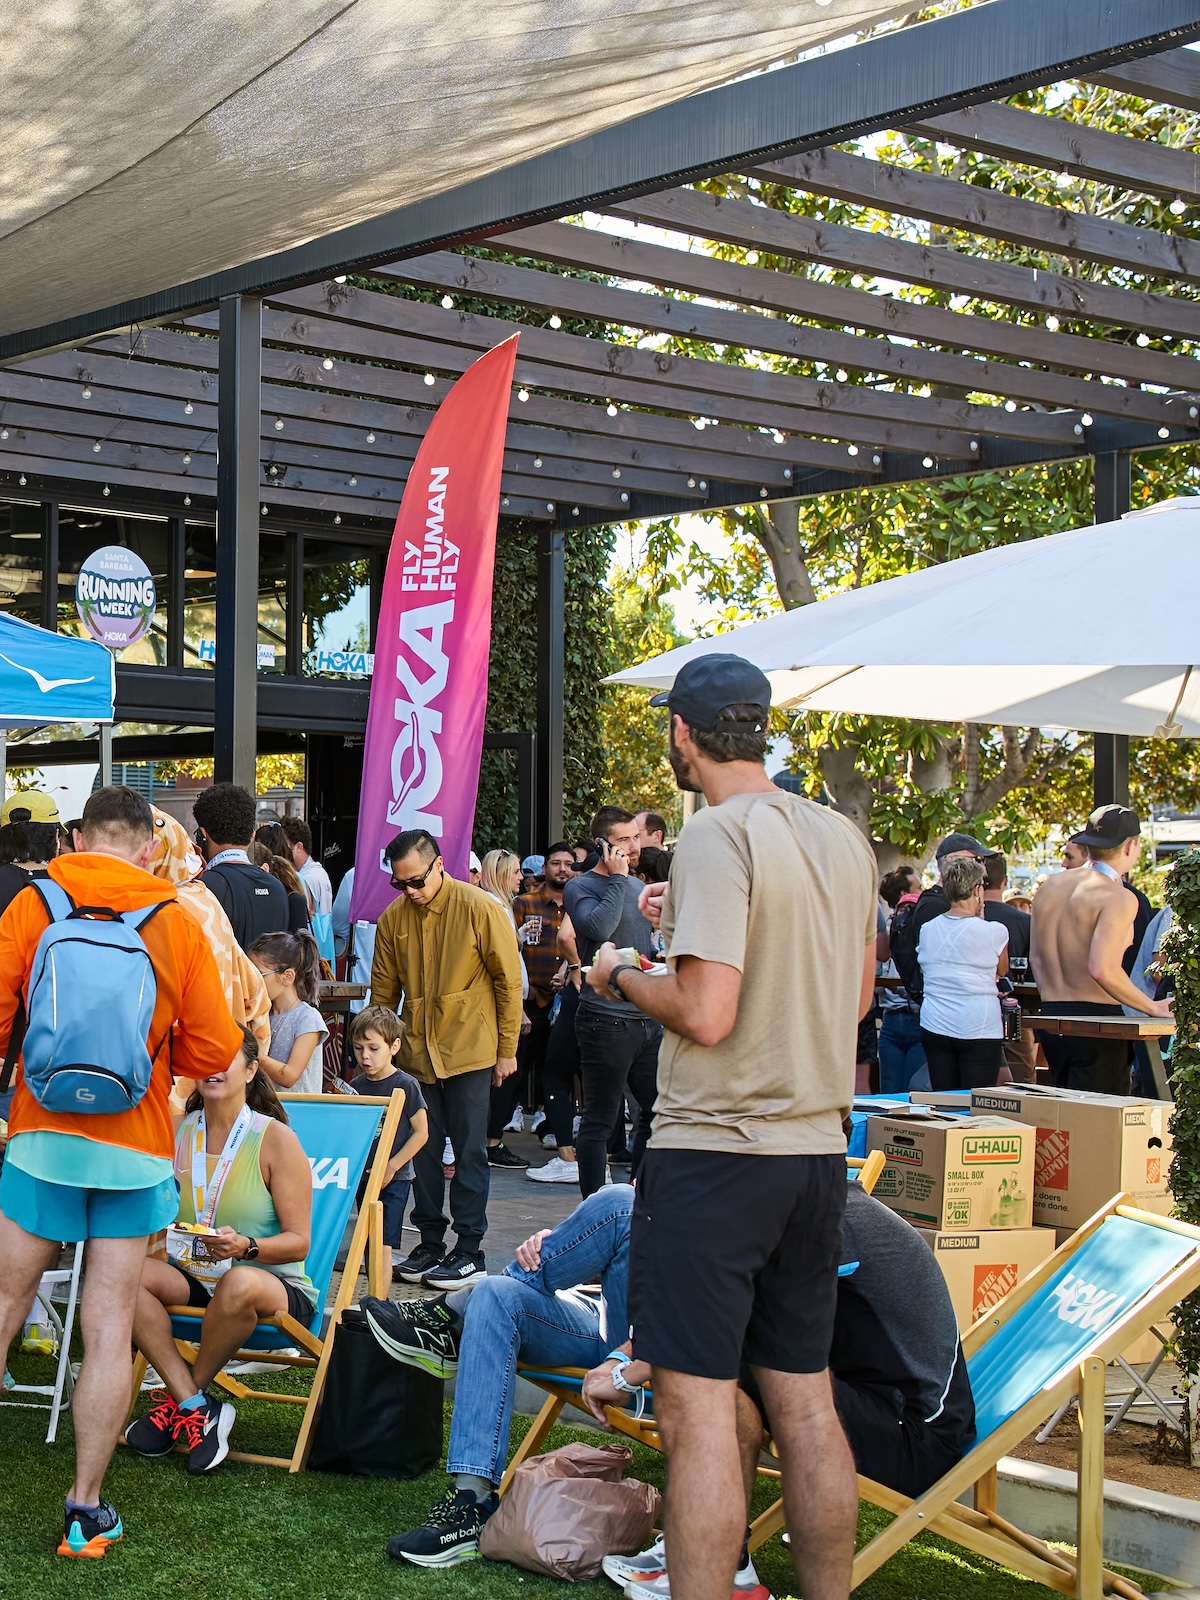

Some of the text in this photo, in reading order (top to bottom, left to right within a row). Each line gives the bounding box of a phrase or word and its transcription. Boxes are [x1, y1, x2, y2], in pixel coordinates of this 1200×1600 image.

[420, 467, 449, 591] HUMAN
[105, 553, 129, 563] SANTA
[440, 538, 460, 591] FLY
[100, 561, 133, 571] BARBARA
[401, 540, 422, 591] FLY
[78, 572, 154, 607] RUNNING
[100, 602, 132, 616] WEEK
[104, 631, 127, 641] HOKA
[318, 651, 366, 672] HOKA
[975, 1097, 1017, 1111] MEDIUM
[230, 1129, 242, 1149] PRESENTED
[887, 1147, 920, 1160] U-HAUL
[966, 1141, 1017, 1153] U-HAUL
[1035, 1131, 1069, 1171] OME
[309, 1158, 349, 1190] KA
[880, 1170, 896, 1178] VE!
[947, 1171, 984, 1180] SMALL BOX
[1036, 1153, 1069, 1187] DEPOT
[1039, 1192, 1061, 1202] doers
[1048, 1202, 1070, 1212] done.
[955, 1210, 968, 1219] OK
[941, 1238, 976, 1247] MEDIUM
[458, 1263, 476, 1276] HOKA
[977, 1271, 997, 1296] THE
[1049, 1273, 1126, 1332] HOKA
[440, 1531, 458, 1545] new
